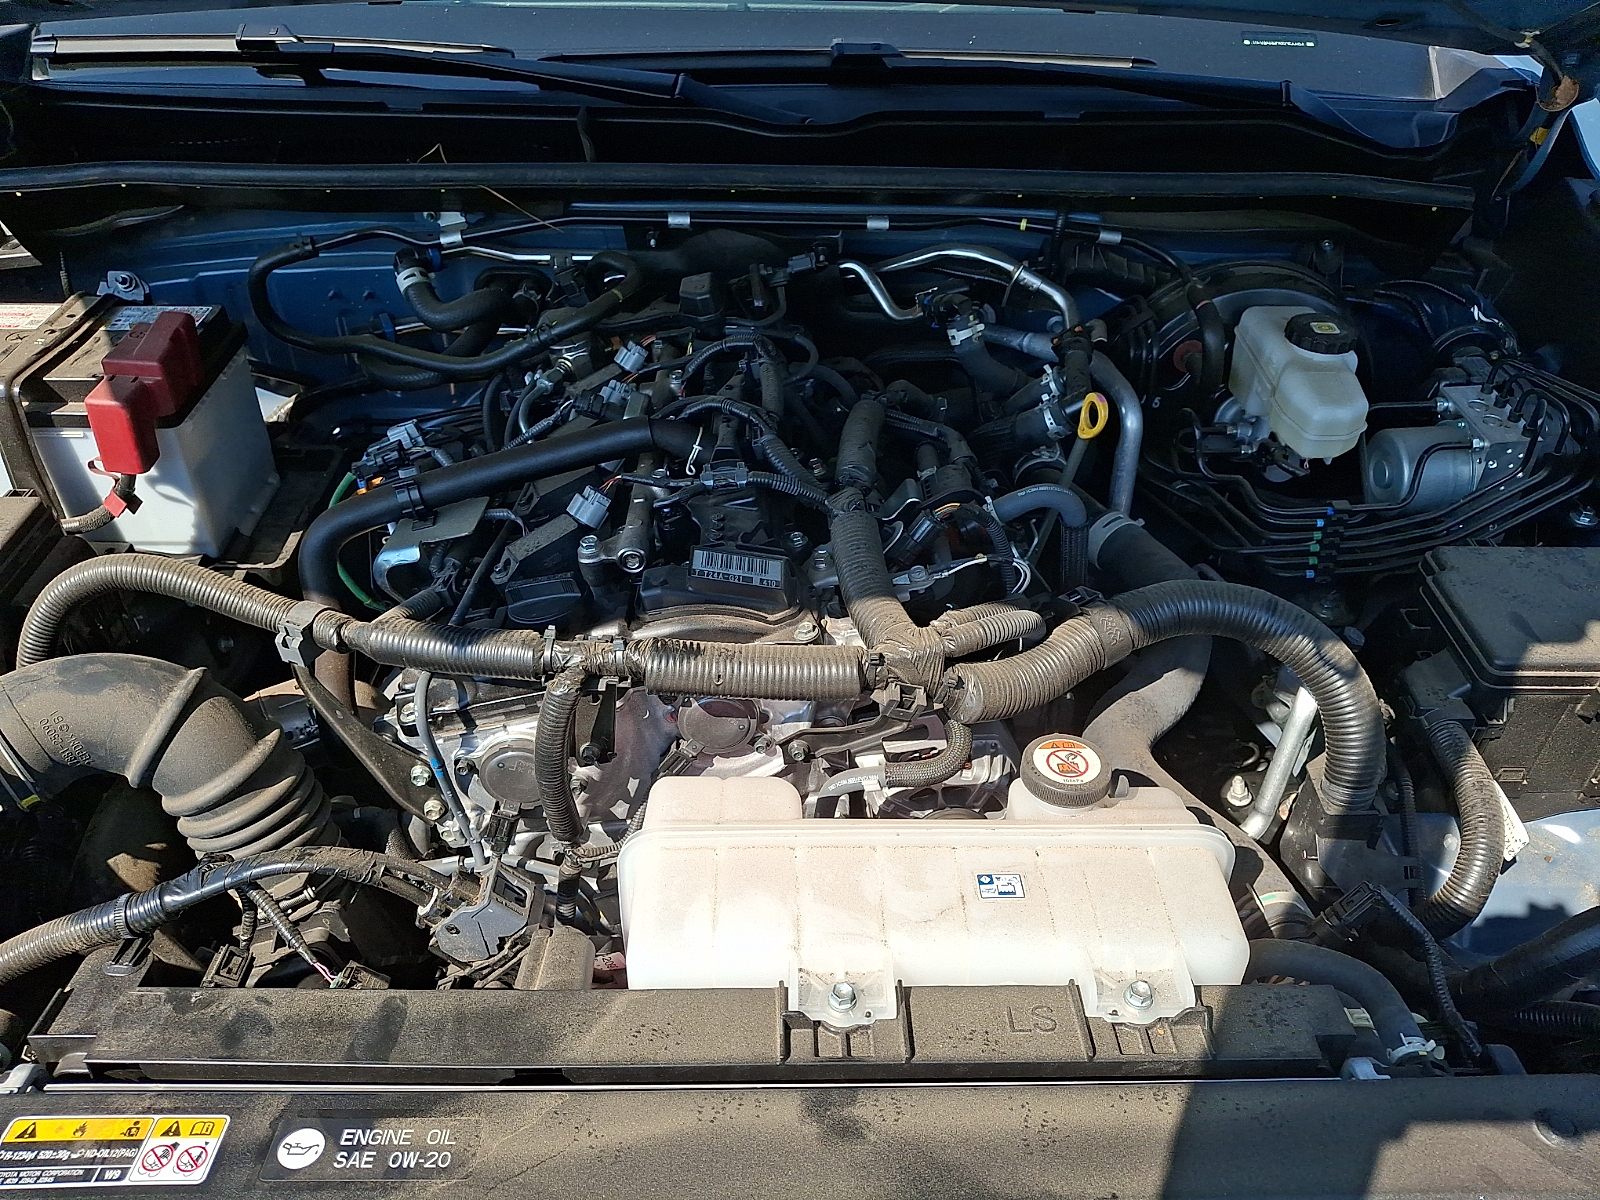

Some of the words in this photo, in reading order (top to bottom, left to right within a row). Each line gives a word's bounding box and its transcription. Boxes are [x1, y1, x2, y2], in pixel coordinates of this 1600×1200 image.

[763, 580, 776, 588] 410
[1007, 1005, 1057, 1033] LS
[340, 1128, 414, 1146] ENGINE
[427, 1128, 457, 1145] OIL
[333, 1151, 377, 1169] SAE
[388, 1151, 452, 1169] 0W-20
[42, 1169, 85, 1177] CORPORATION
[104, 1169, 121, 1180] W9
